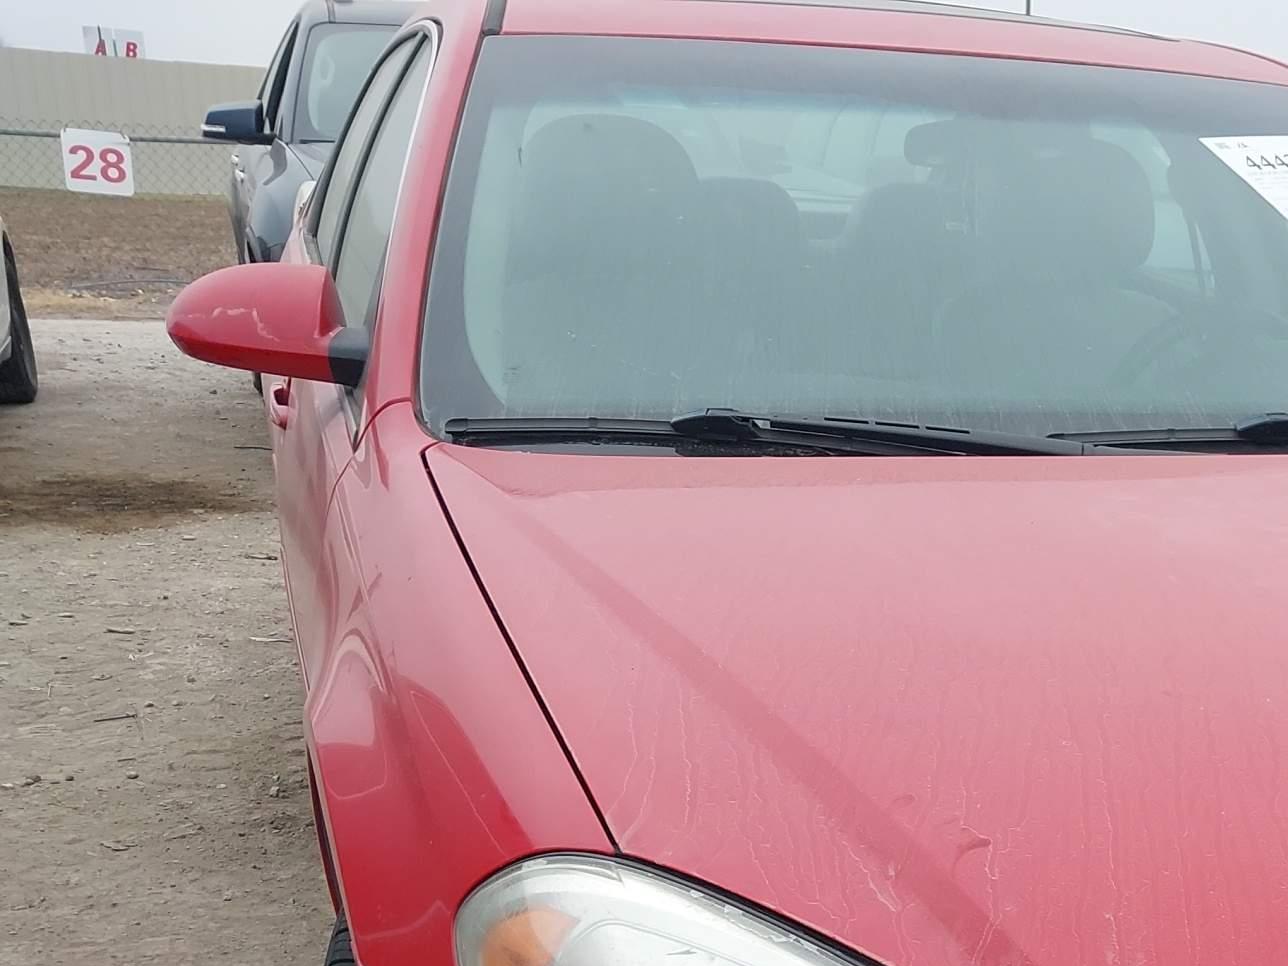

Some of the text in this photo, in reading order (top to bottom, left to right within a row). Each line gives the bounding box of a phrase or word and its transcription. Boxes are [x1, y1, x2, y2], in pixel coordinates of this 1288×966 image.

[94, 39, 107, 57] A
[126, 42, 138, 58] B
[68, 144, 128, 184] 28
